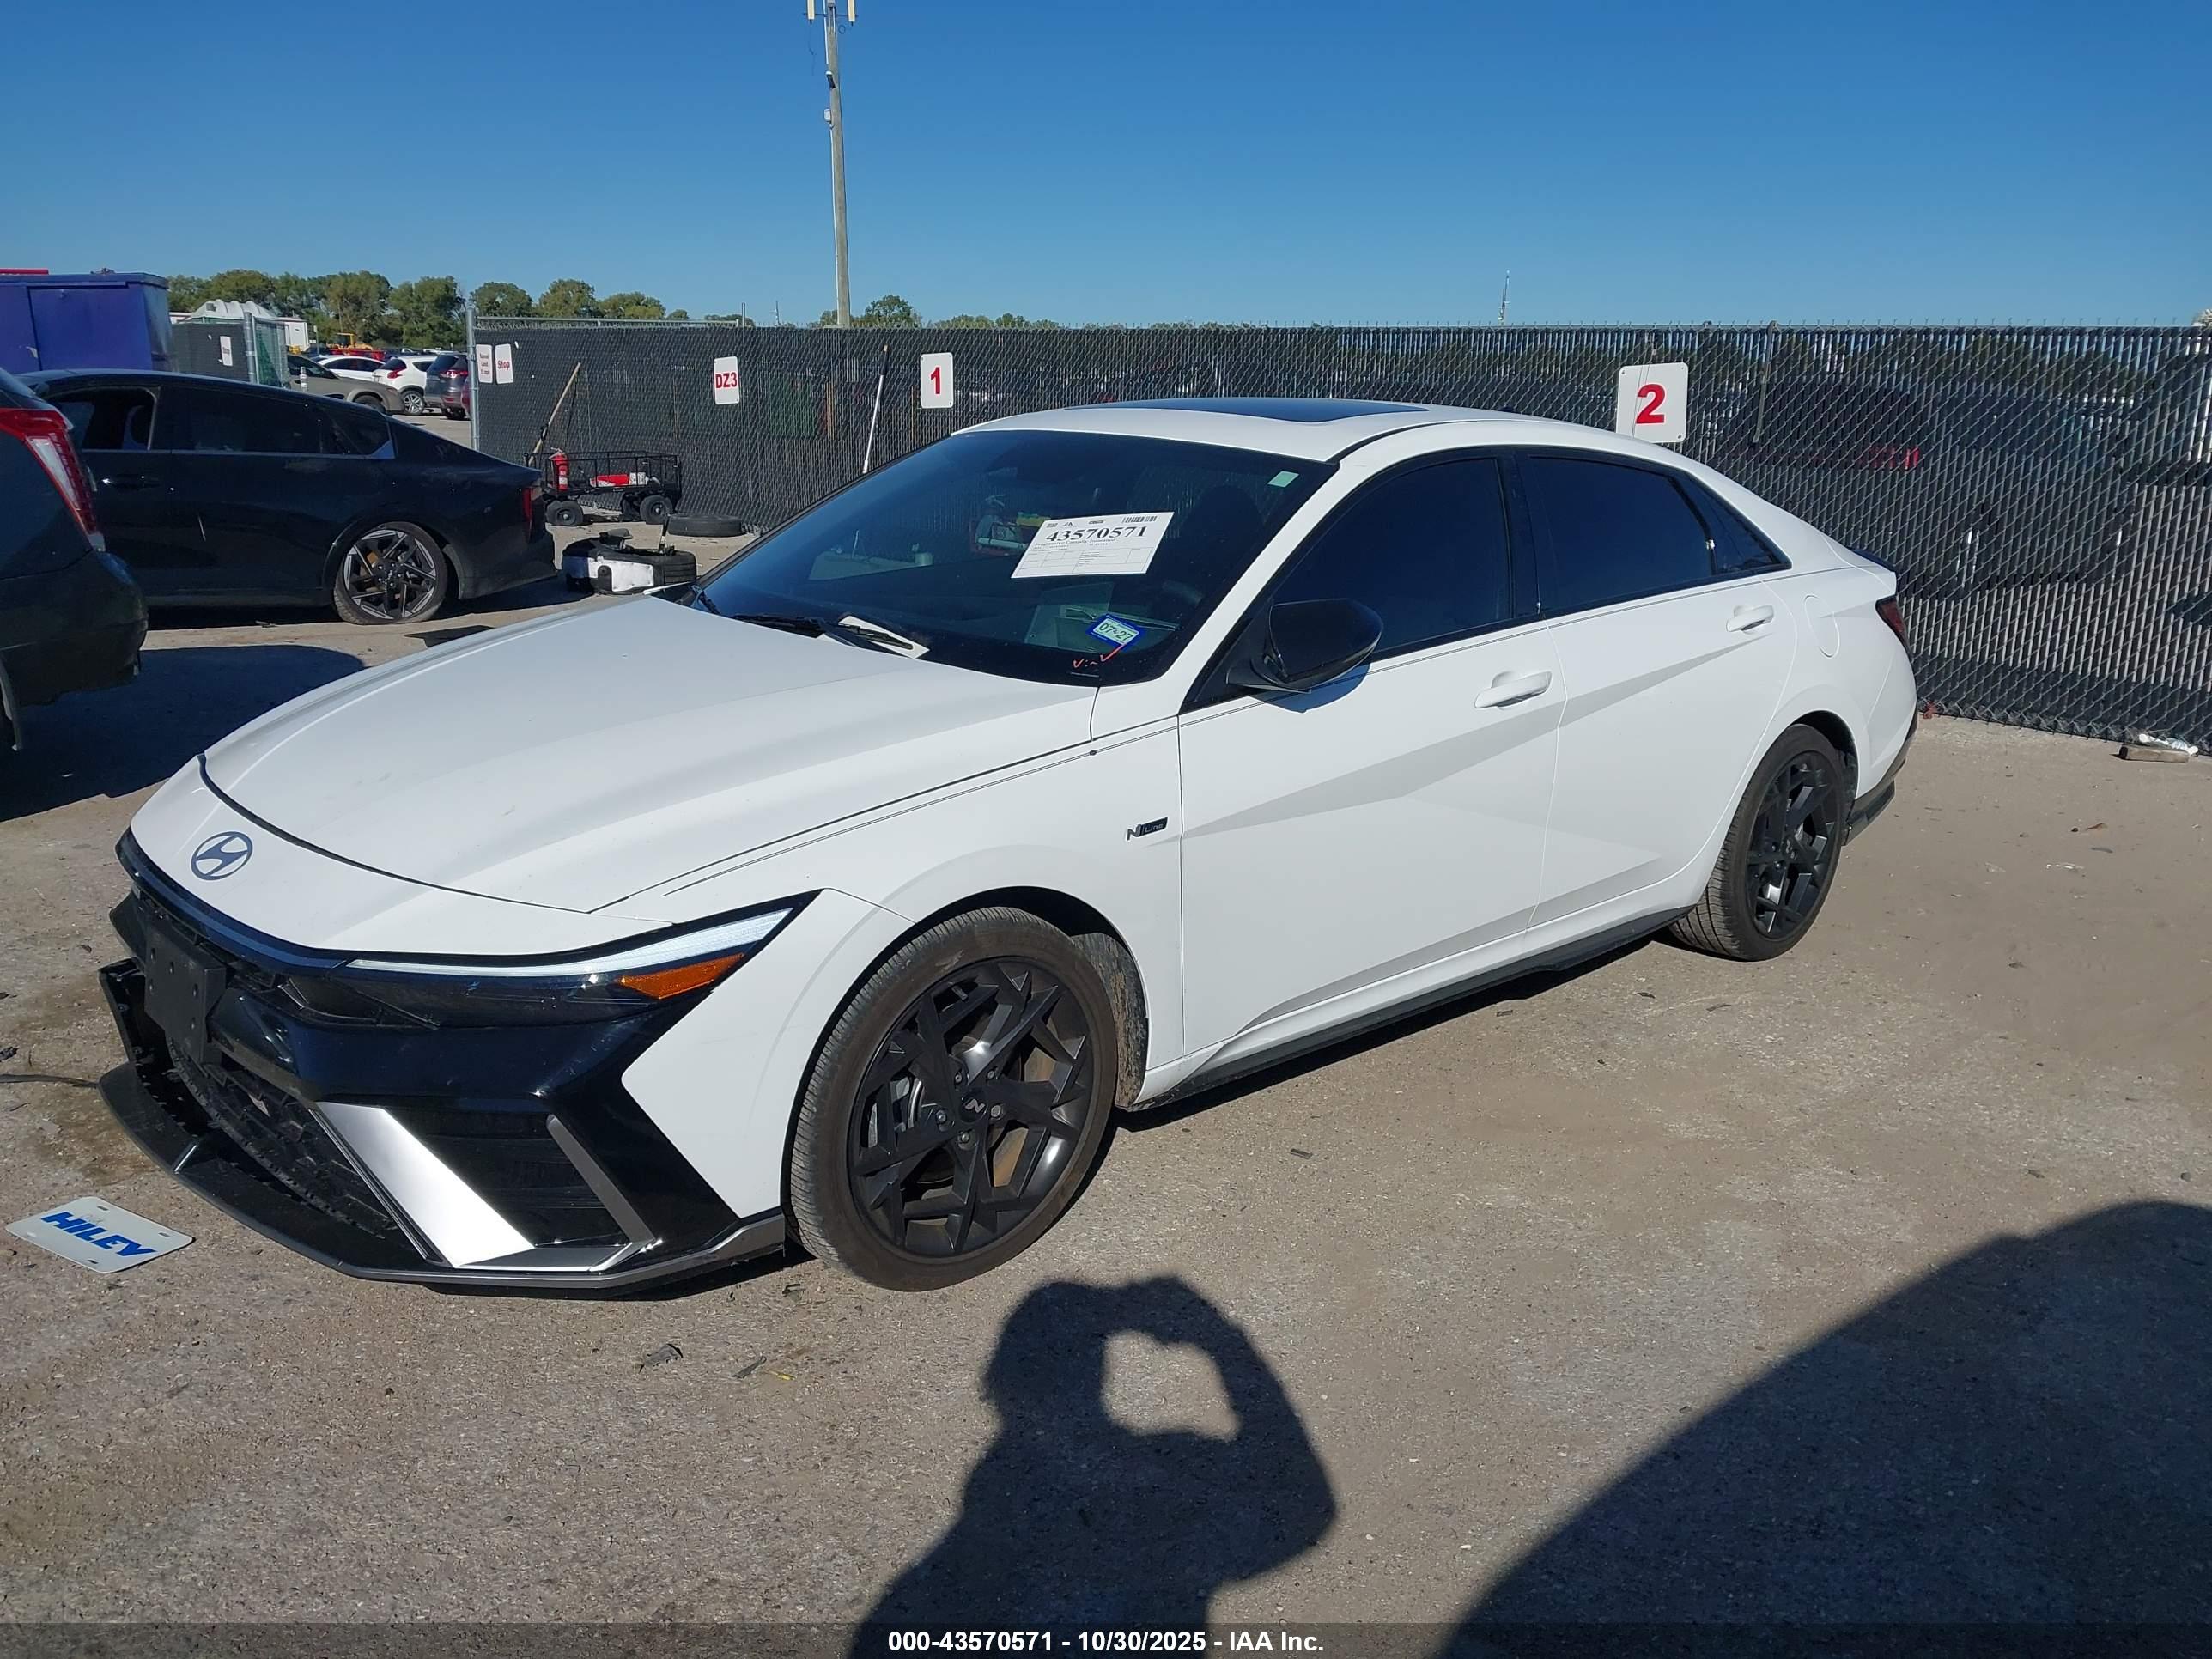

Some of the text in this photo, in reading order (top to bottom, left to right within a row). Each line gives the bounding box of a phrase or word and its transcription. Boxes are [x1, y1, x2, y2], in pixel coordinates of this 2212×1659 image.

[497, 361, 510, 370] Stop
[715, 372, 738, 389] DZ3
[930, 367, 941, 395] 1
[1635, 384, 1666, 424] 2
[1046, 526, 1148, 542] 43570571
[1116, 630, 1134, 641] 27
[41, 1212, 158, 1257] HILEY
